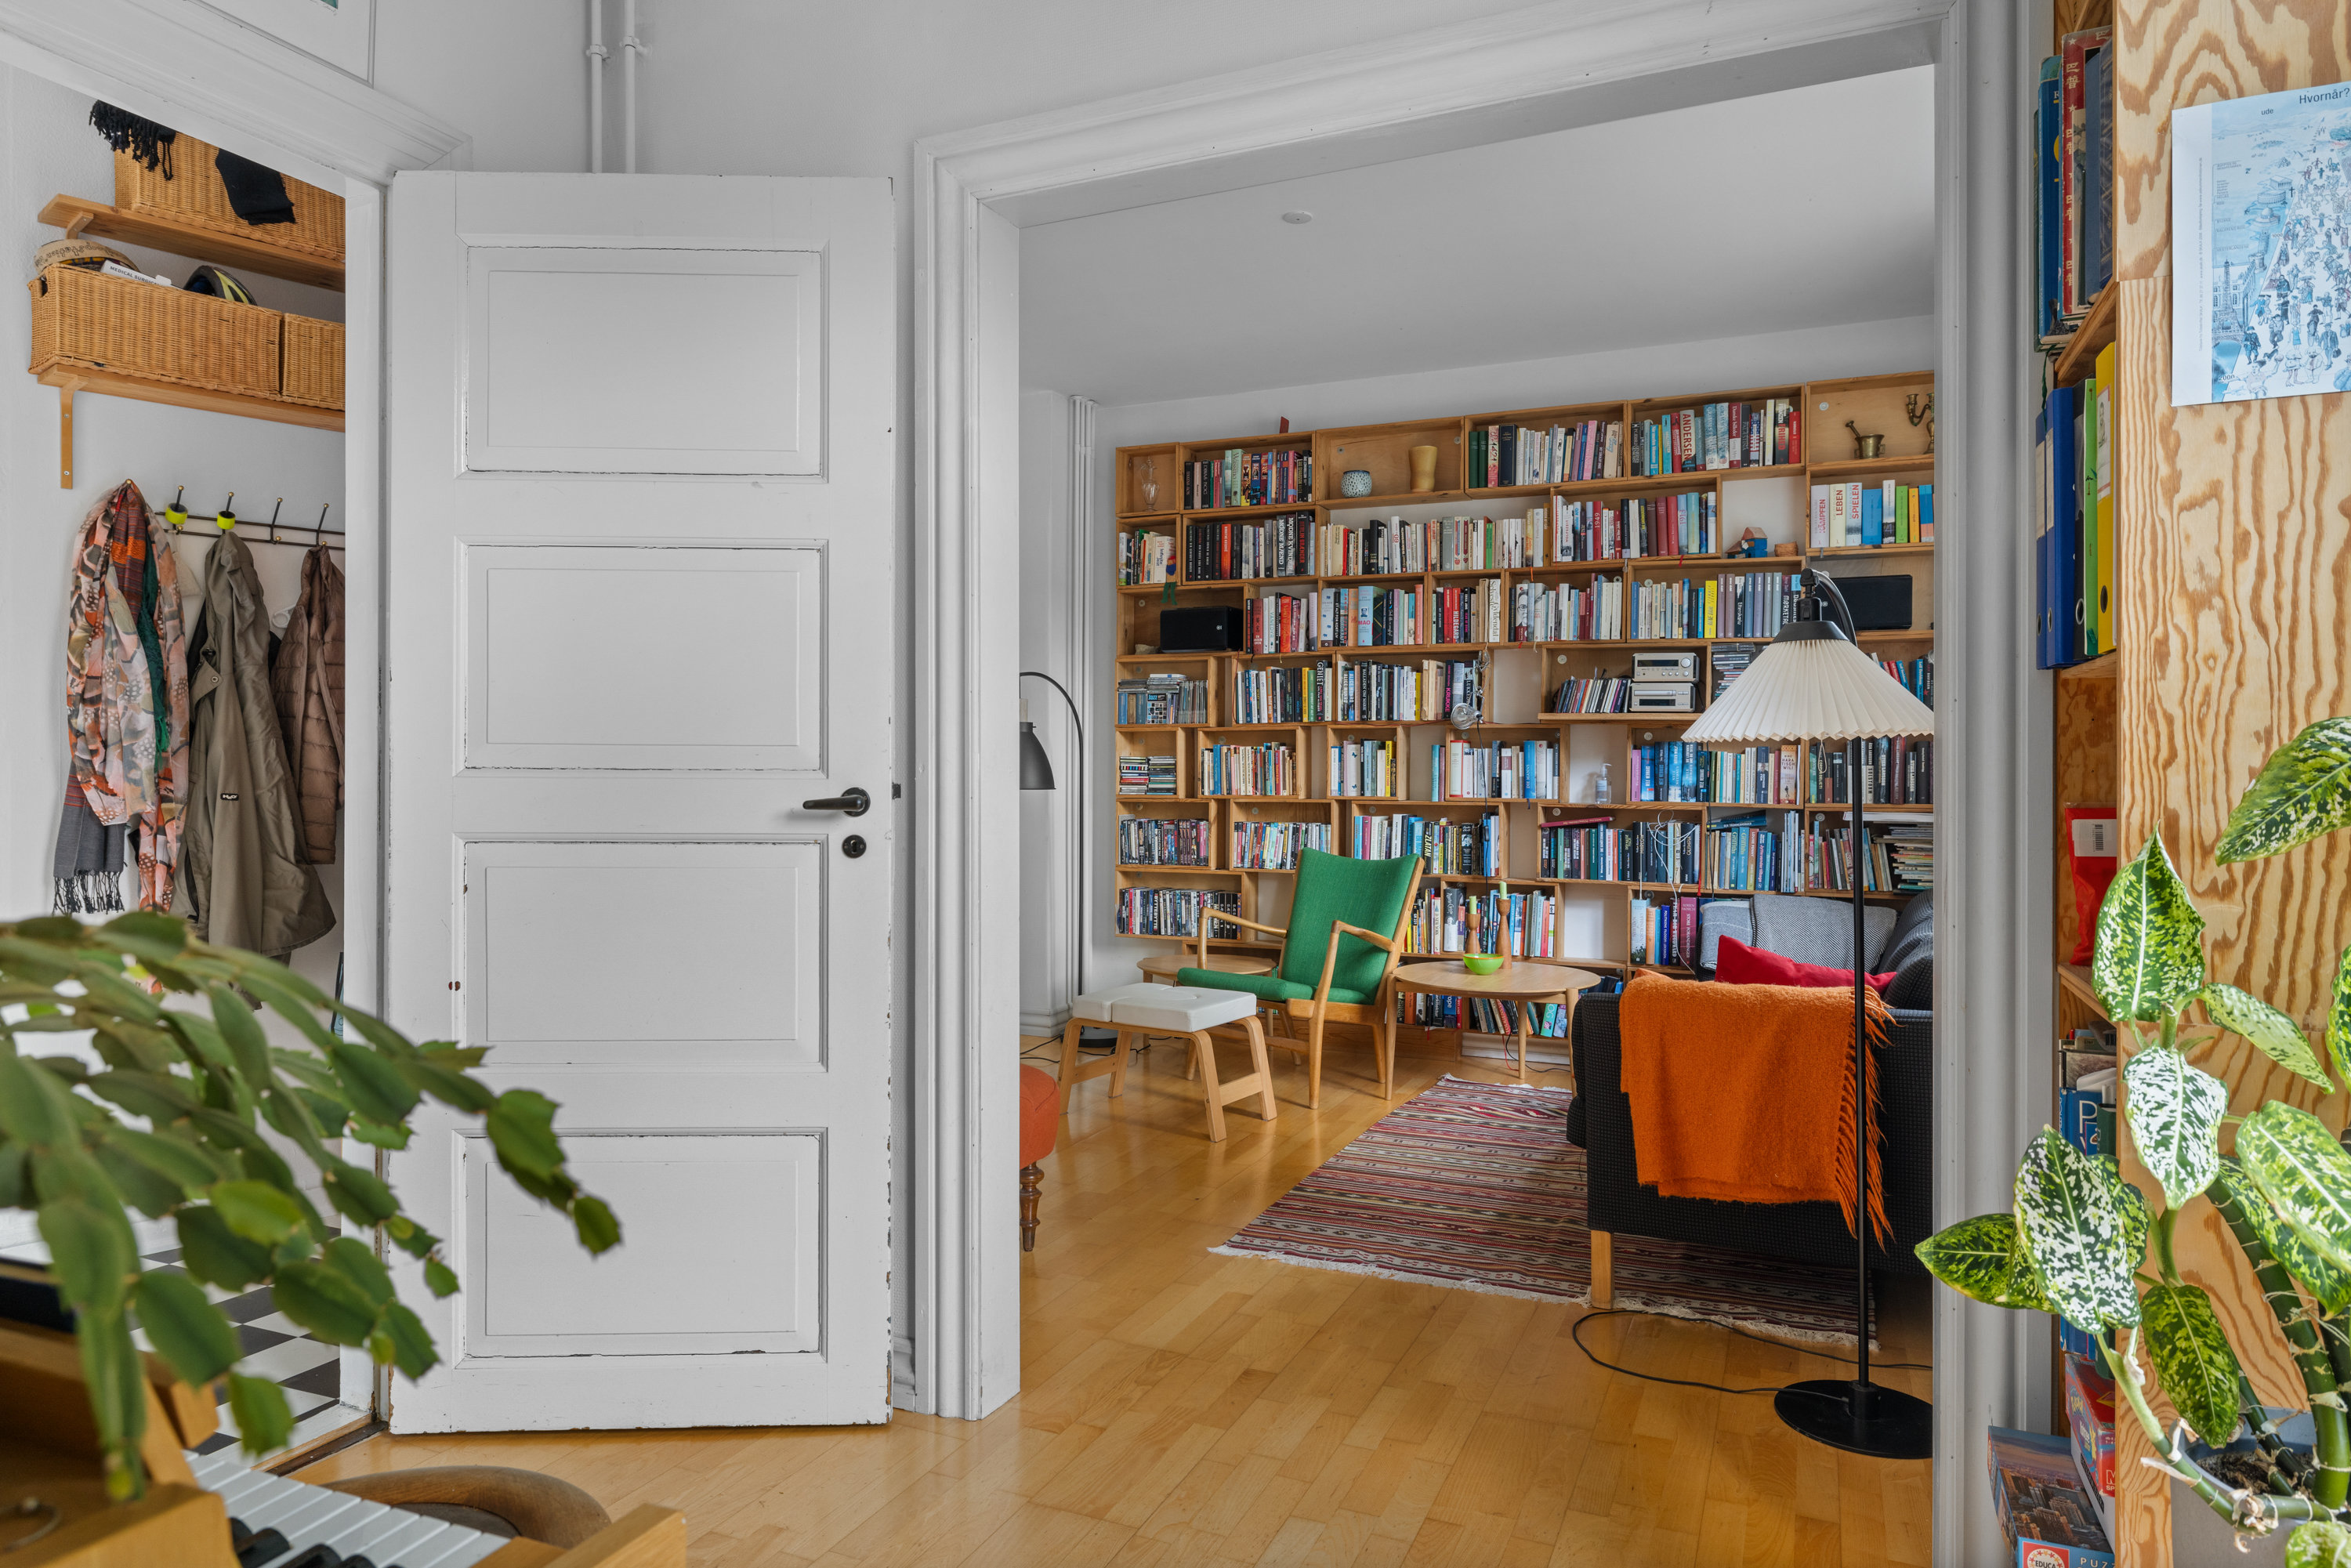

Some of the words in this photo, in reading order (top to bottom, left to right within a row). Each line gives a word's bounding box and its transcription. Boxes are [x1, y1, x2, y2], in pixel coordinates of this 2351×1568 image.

[2299, 88, 2350, 104] Hvornår?
[109, 265, 133, 279] MEDICAL
[1683, 414, 1692, 460] ANDERSEN
[2035, 1560, 2056, 1568] EDUCA
